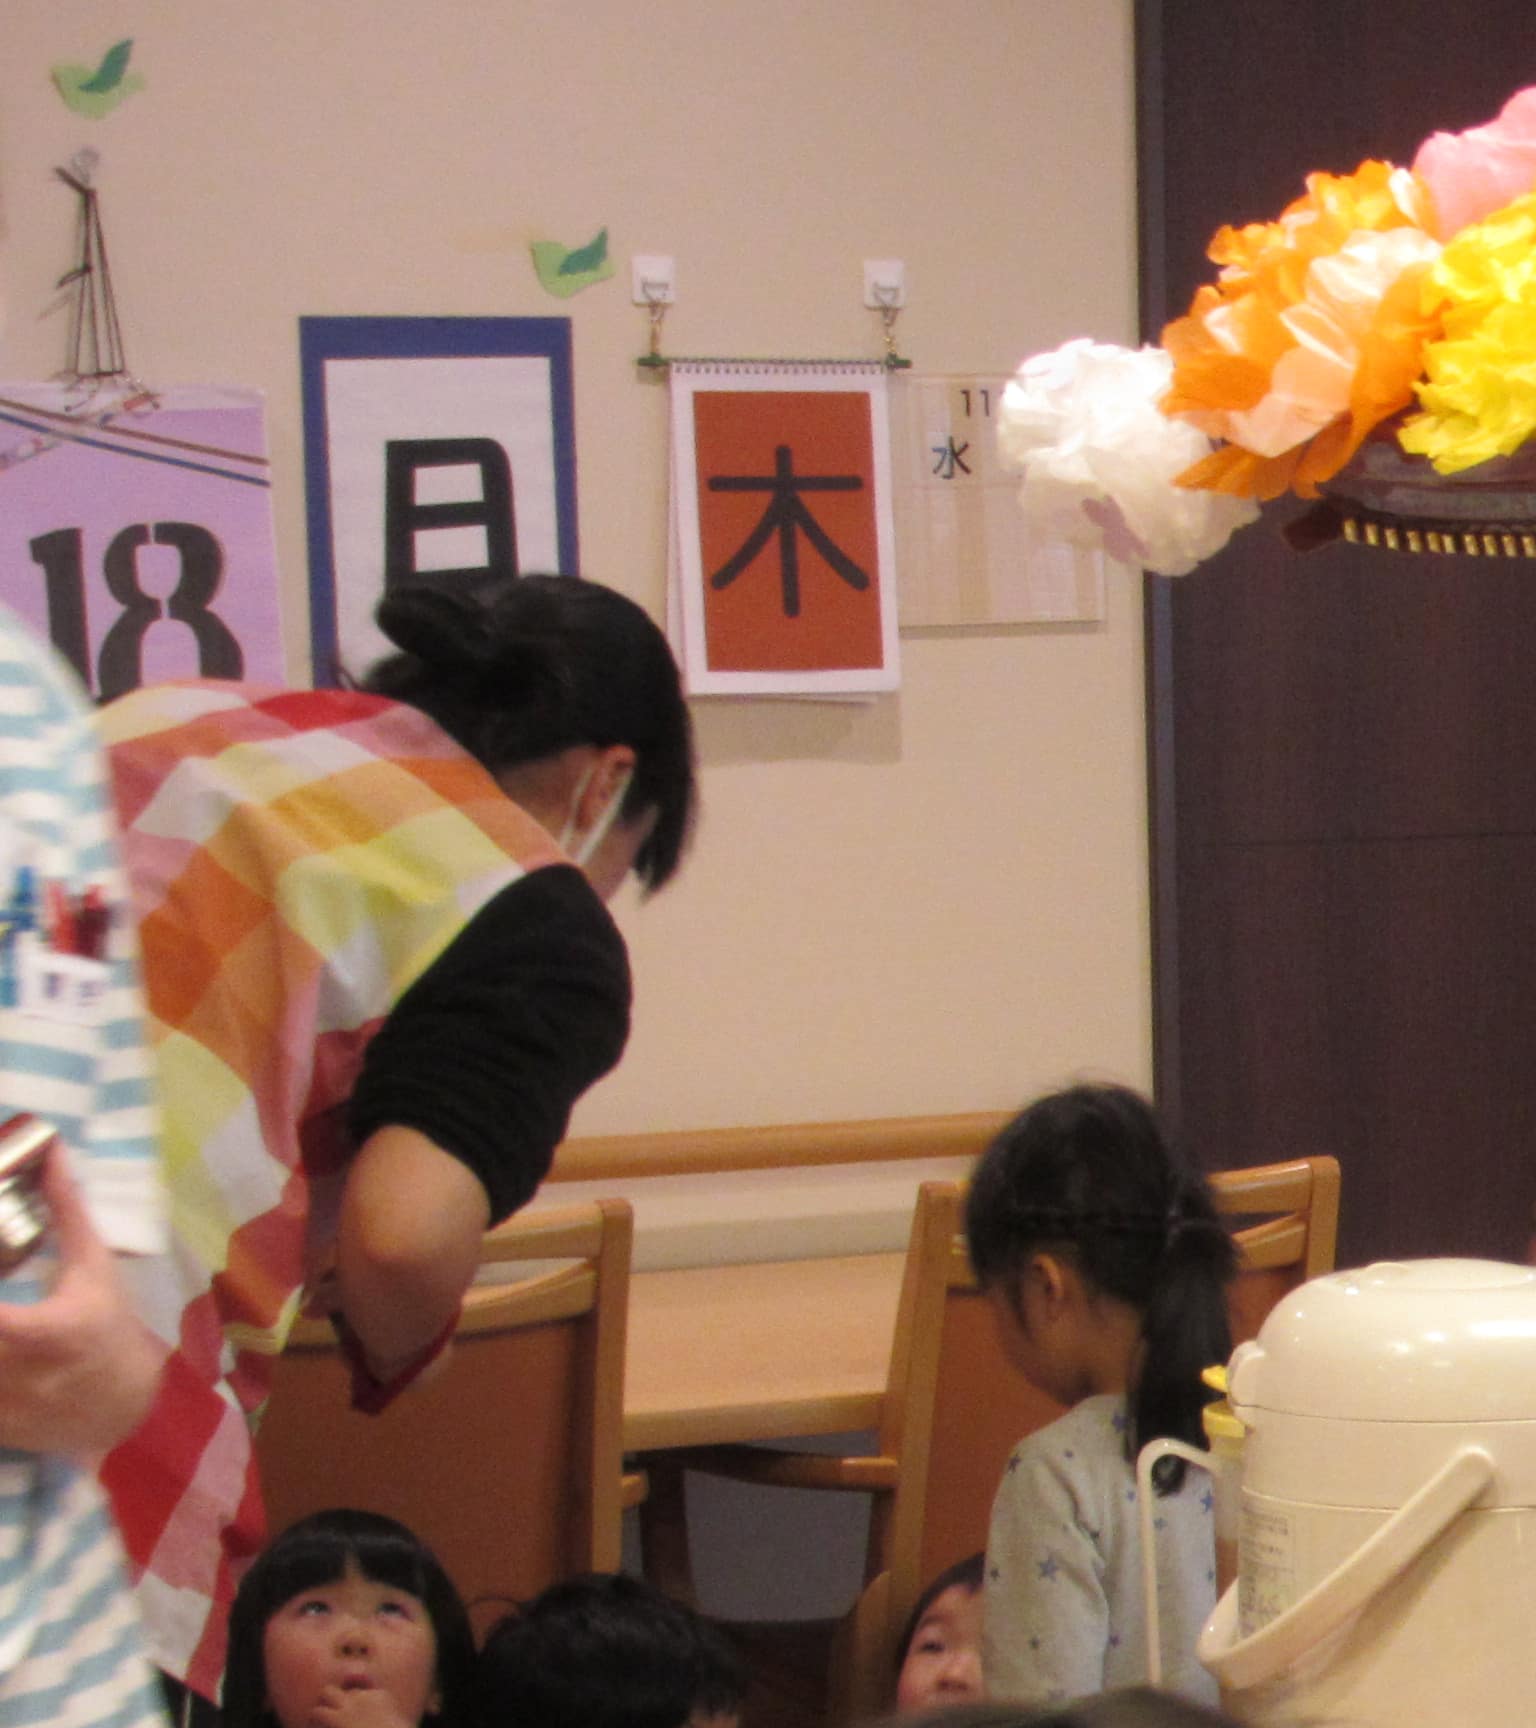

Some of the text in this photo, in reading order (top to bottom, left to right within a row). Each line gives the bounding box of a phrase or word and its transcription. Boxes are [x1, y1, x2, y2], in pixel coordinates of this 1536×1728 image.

[931, 435, 971, 480] 水
[961, 389, 990, 417] 11
[707, 444, 870, 618] 木
[29, 521, 245, 706] 18
